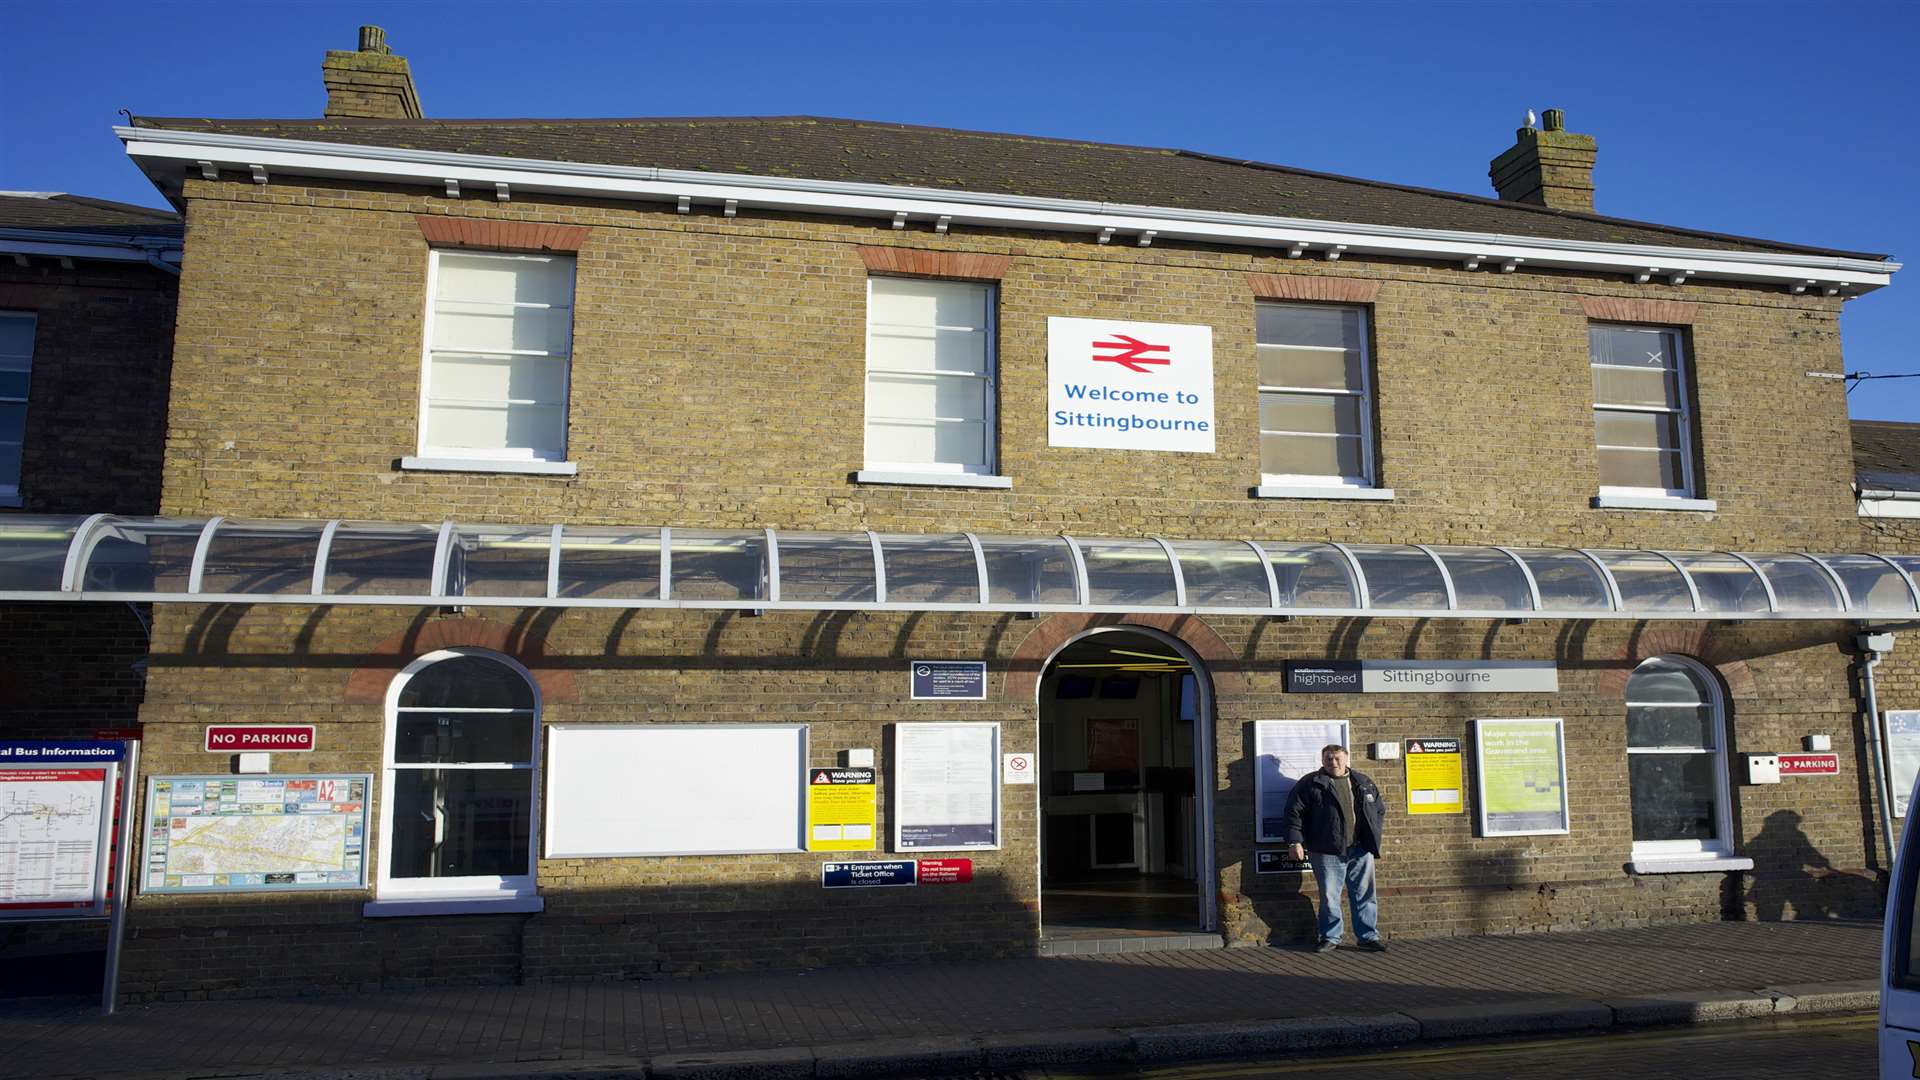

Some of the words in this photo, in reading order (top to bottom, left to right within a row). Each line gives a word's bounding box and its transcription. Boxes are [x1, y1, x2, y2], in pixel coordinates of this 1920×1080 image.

[1064, 384, 1169, 403] Welcome
[1176, 391, 1199, 404] to
[1055, 411, 1209, 431] Sittingbourne
[1294, 673, 1356, 685] highspeed
[1383, 669, 1490, 685] Sittingbourne
[213, 734, 236, 743] NO
[242, 733, 308, 743] PARKING
[0, 748, 12, 756] al
[16, 748, 38, 756] Bus
[42, 747, 115, 756] Information
[1793, 760, 1836, 768] PARKING
[319, 780, 335, 801] A2
